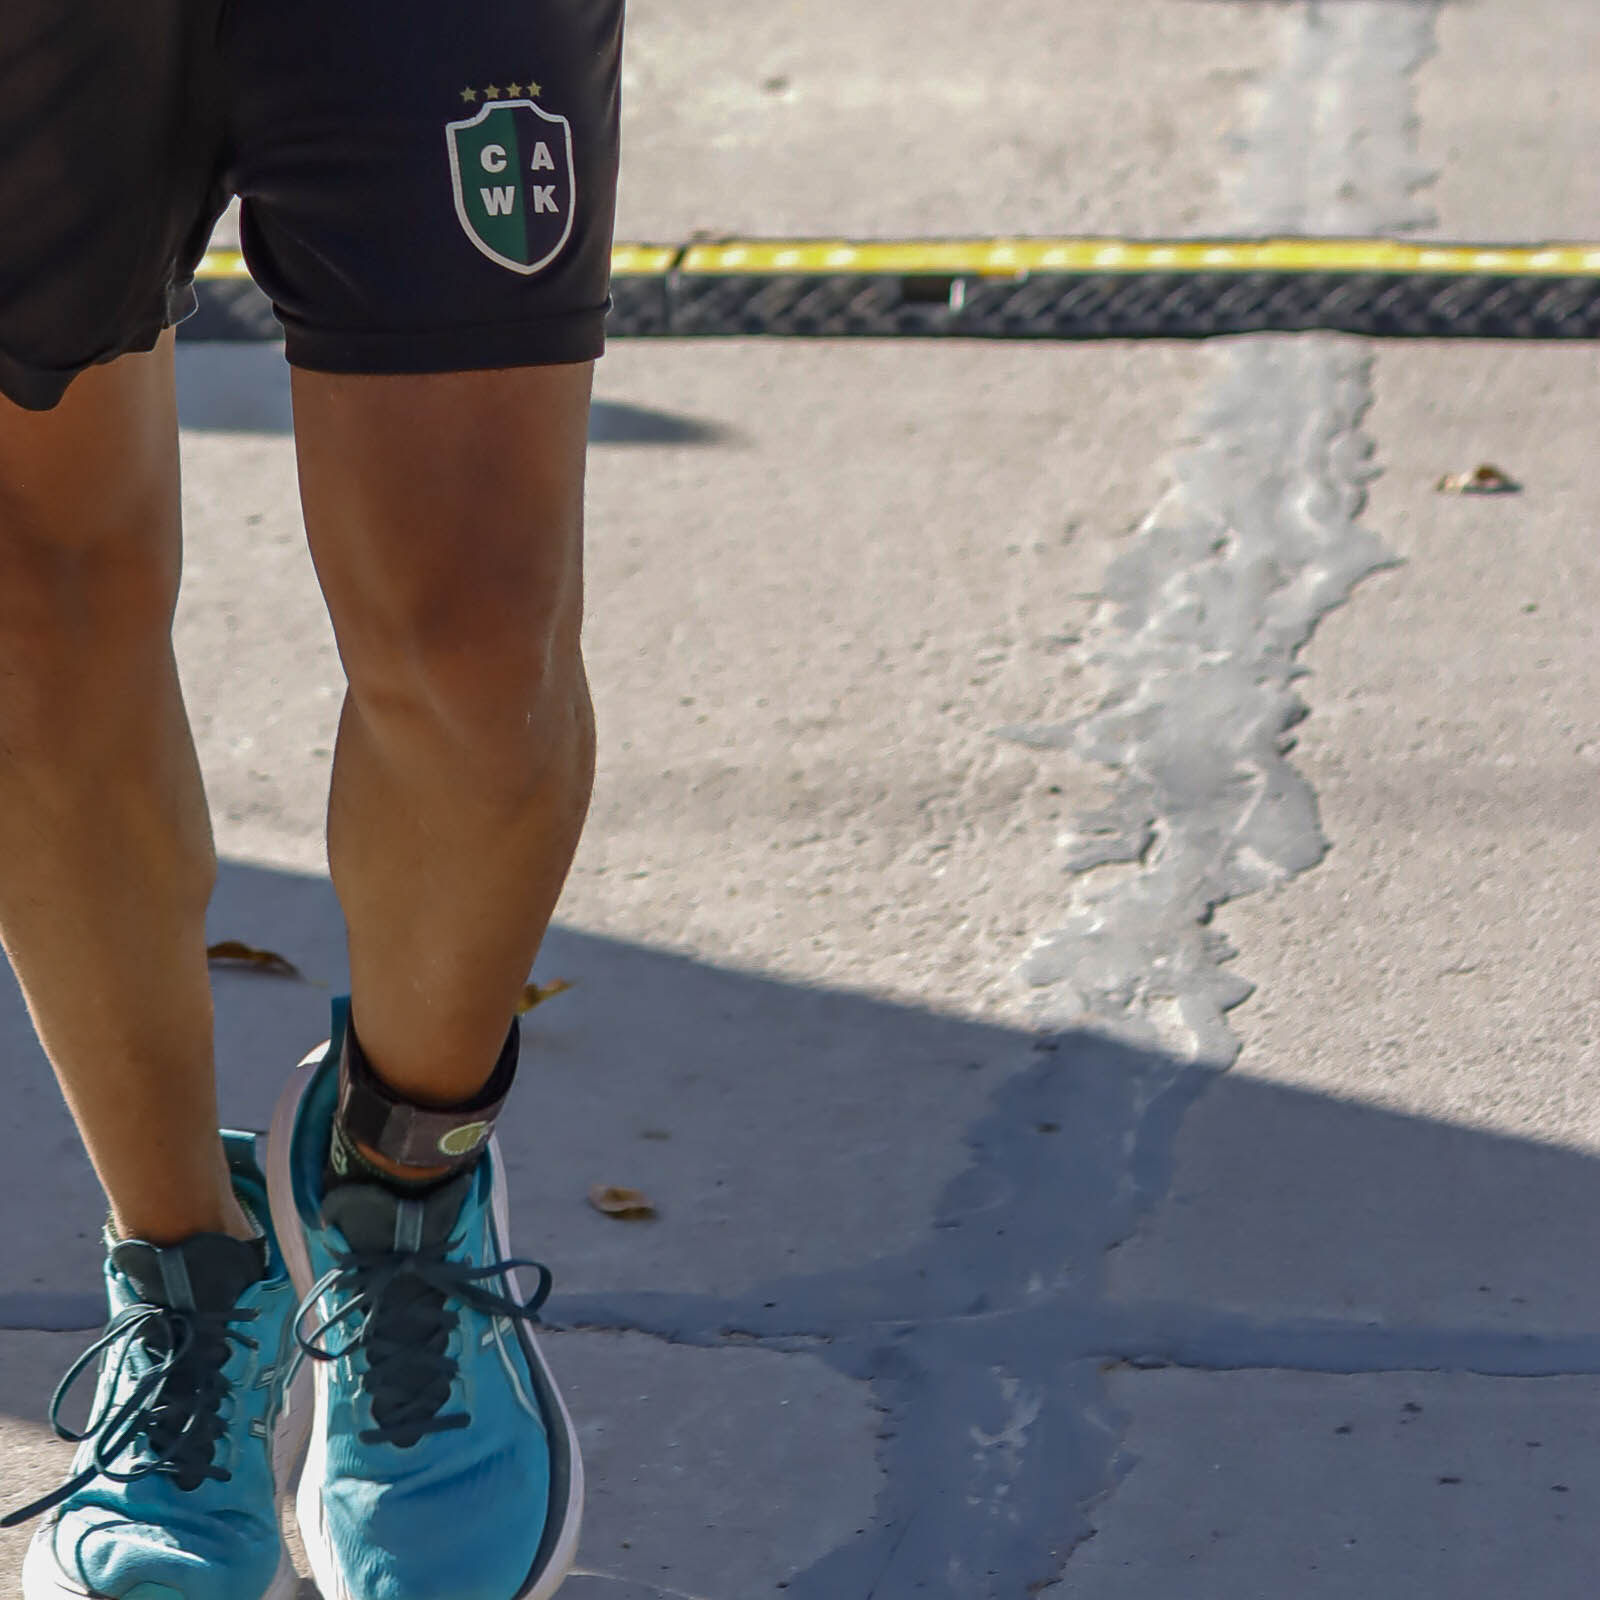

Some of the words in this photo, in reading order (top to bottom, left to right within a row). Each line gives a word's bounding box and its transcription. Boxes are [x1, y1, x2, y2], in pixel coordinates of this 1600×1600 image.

[480, 144, 507, 173] C
[531, 141, 555, 170] A
[480, 186, 515, 216] W
[533, 185, 559, 213] K
